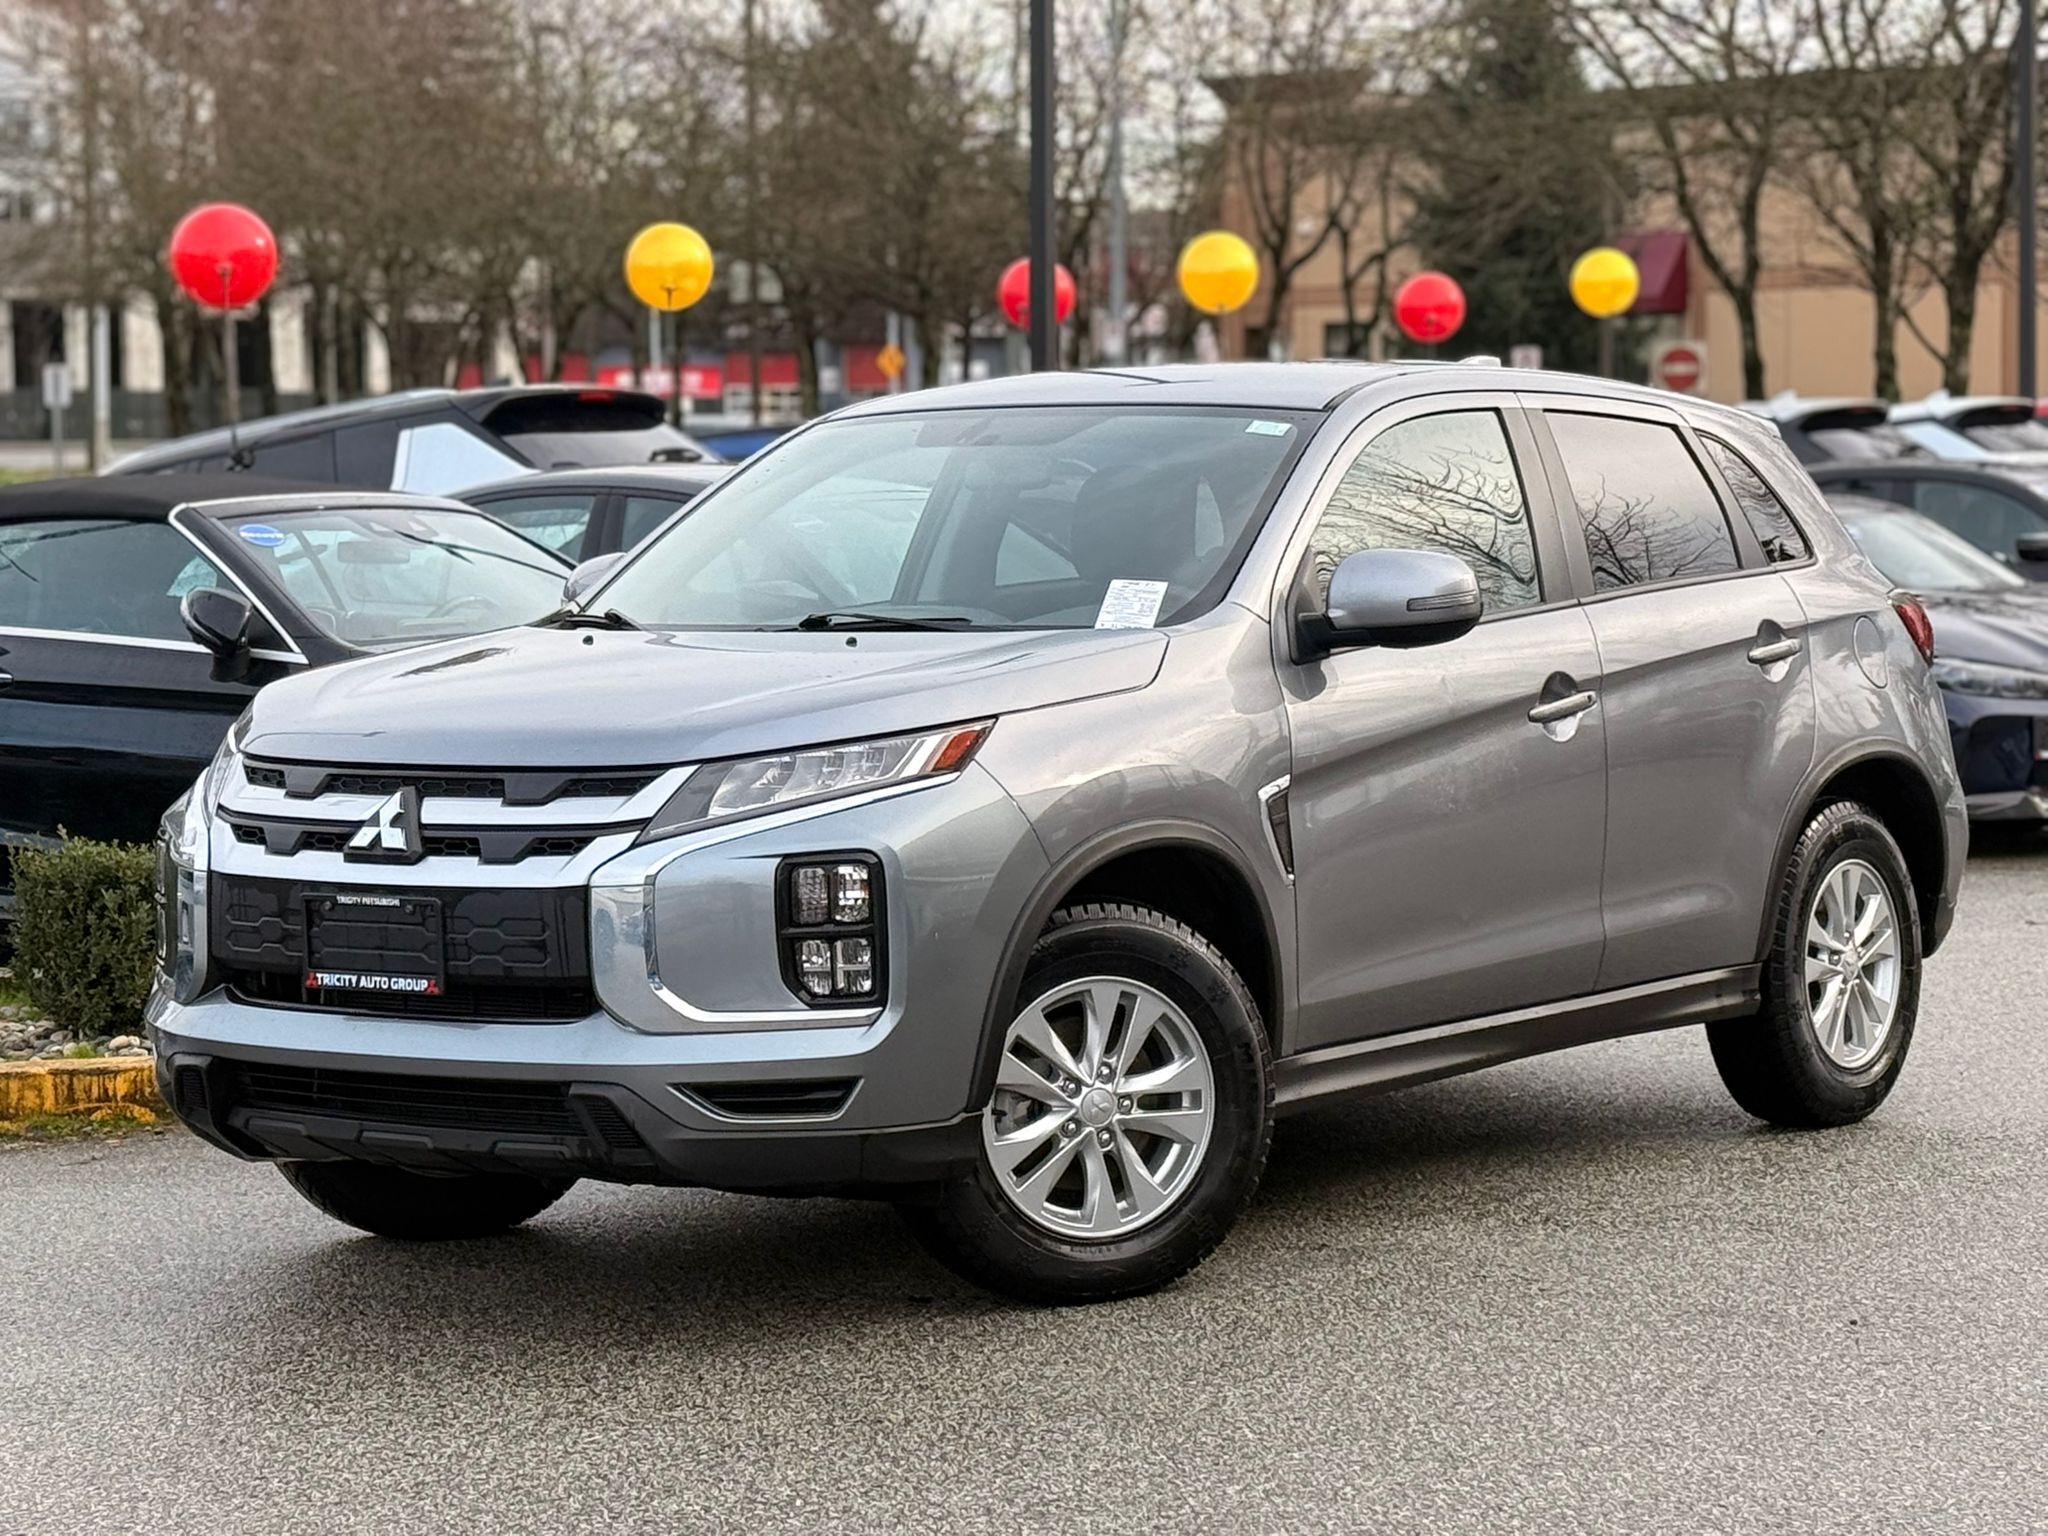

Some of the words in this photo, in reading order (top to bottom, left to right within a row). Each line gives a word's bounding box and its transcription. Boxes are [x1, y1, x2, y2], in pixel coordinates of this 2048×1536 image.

[336, 895, 361, 905] TRICITY
[316, 973, 358, 988] TRICITY
[359, 975, 389, 989] AUTO
[391, 978, 428, 992] GROUP
